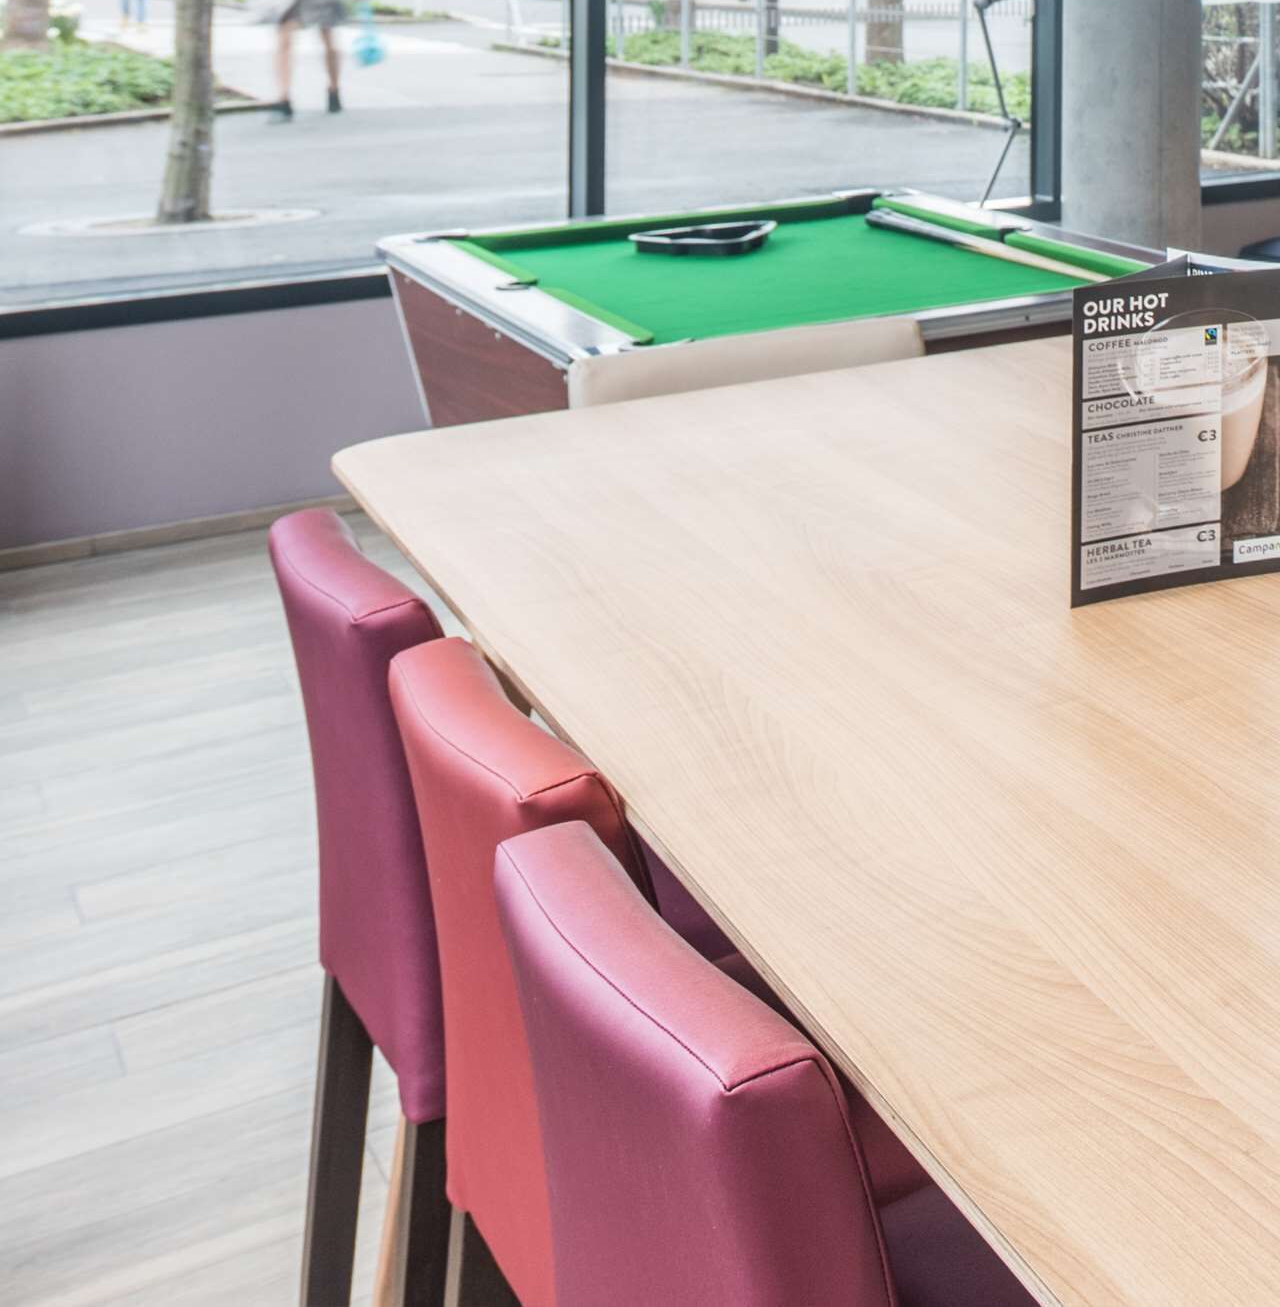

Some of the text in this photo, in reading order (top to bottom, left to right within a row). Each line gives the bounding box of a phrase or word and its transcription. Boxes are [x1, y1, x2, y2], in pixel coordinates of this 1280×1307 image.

[1083, 292, 1169, 316] OUR HOT
[1083, 311, 1155, 334] DRINKS
[1088, 338, 1132, 352] COFFEE
[1087, 395, 1155, 413] CHOCOLATE
[1087, 432, 1115, 445] TEAS
[1086, 538, 1153, 558] HERBAL TEA
